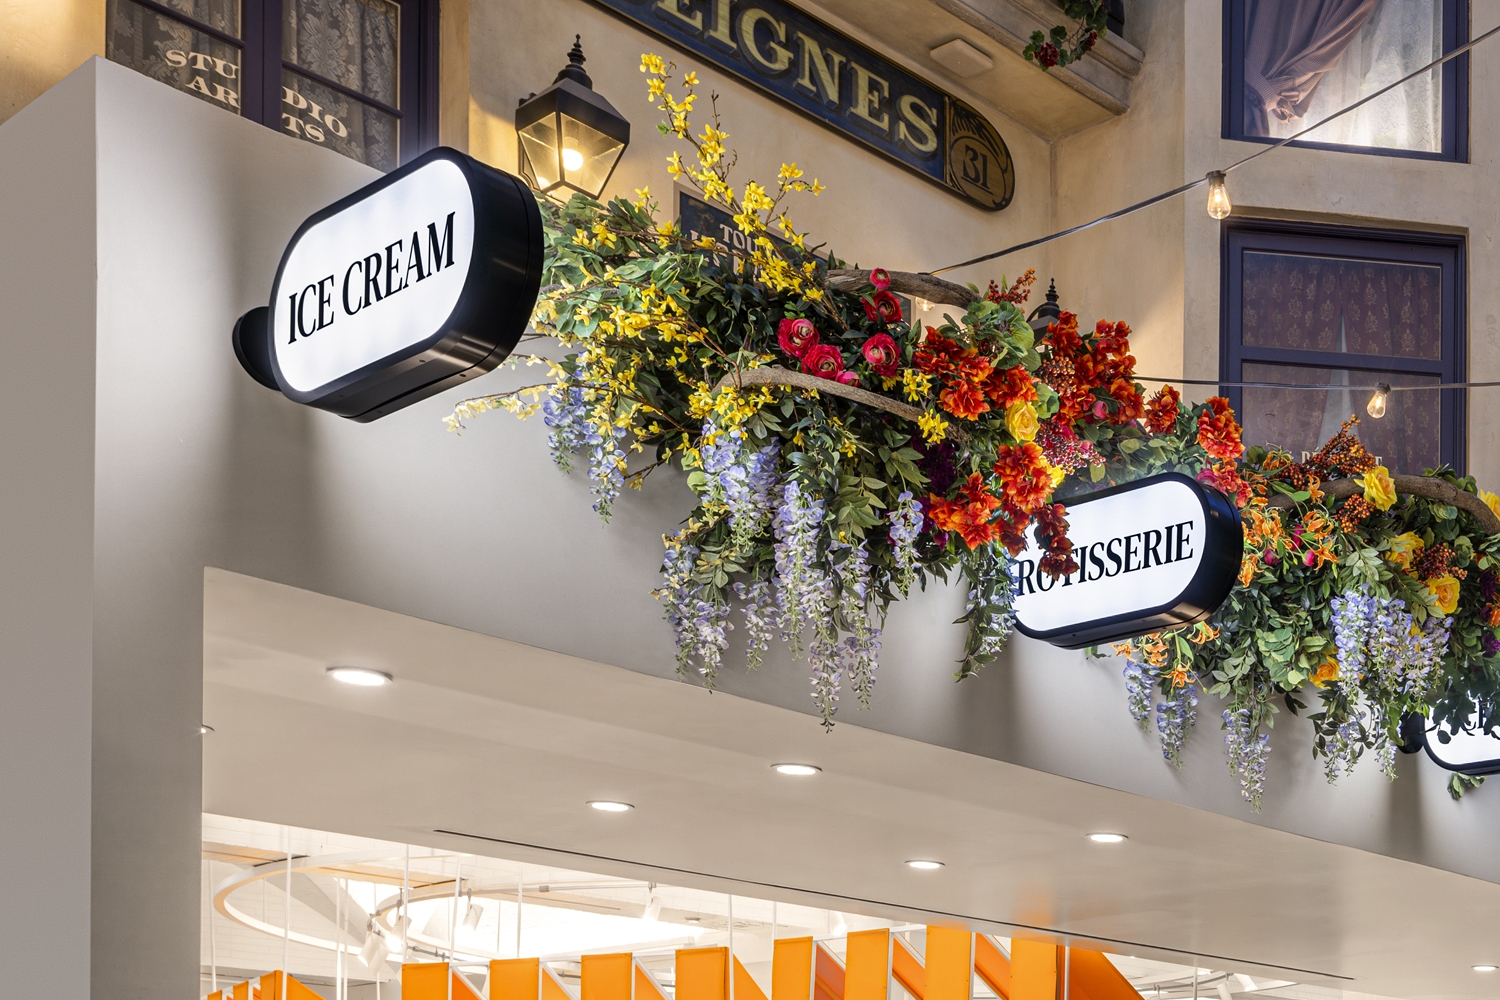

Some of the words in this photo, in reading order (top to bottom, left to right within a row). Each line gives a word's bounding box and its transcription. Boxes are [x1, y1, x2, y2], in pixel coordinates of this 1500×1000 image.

[962, 144, 989, 190] 31
[288, 274, 334, 344] ICE
[342, 211, 456, 316] CREAM
